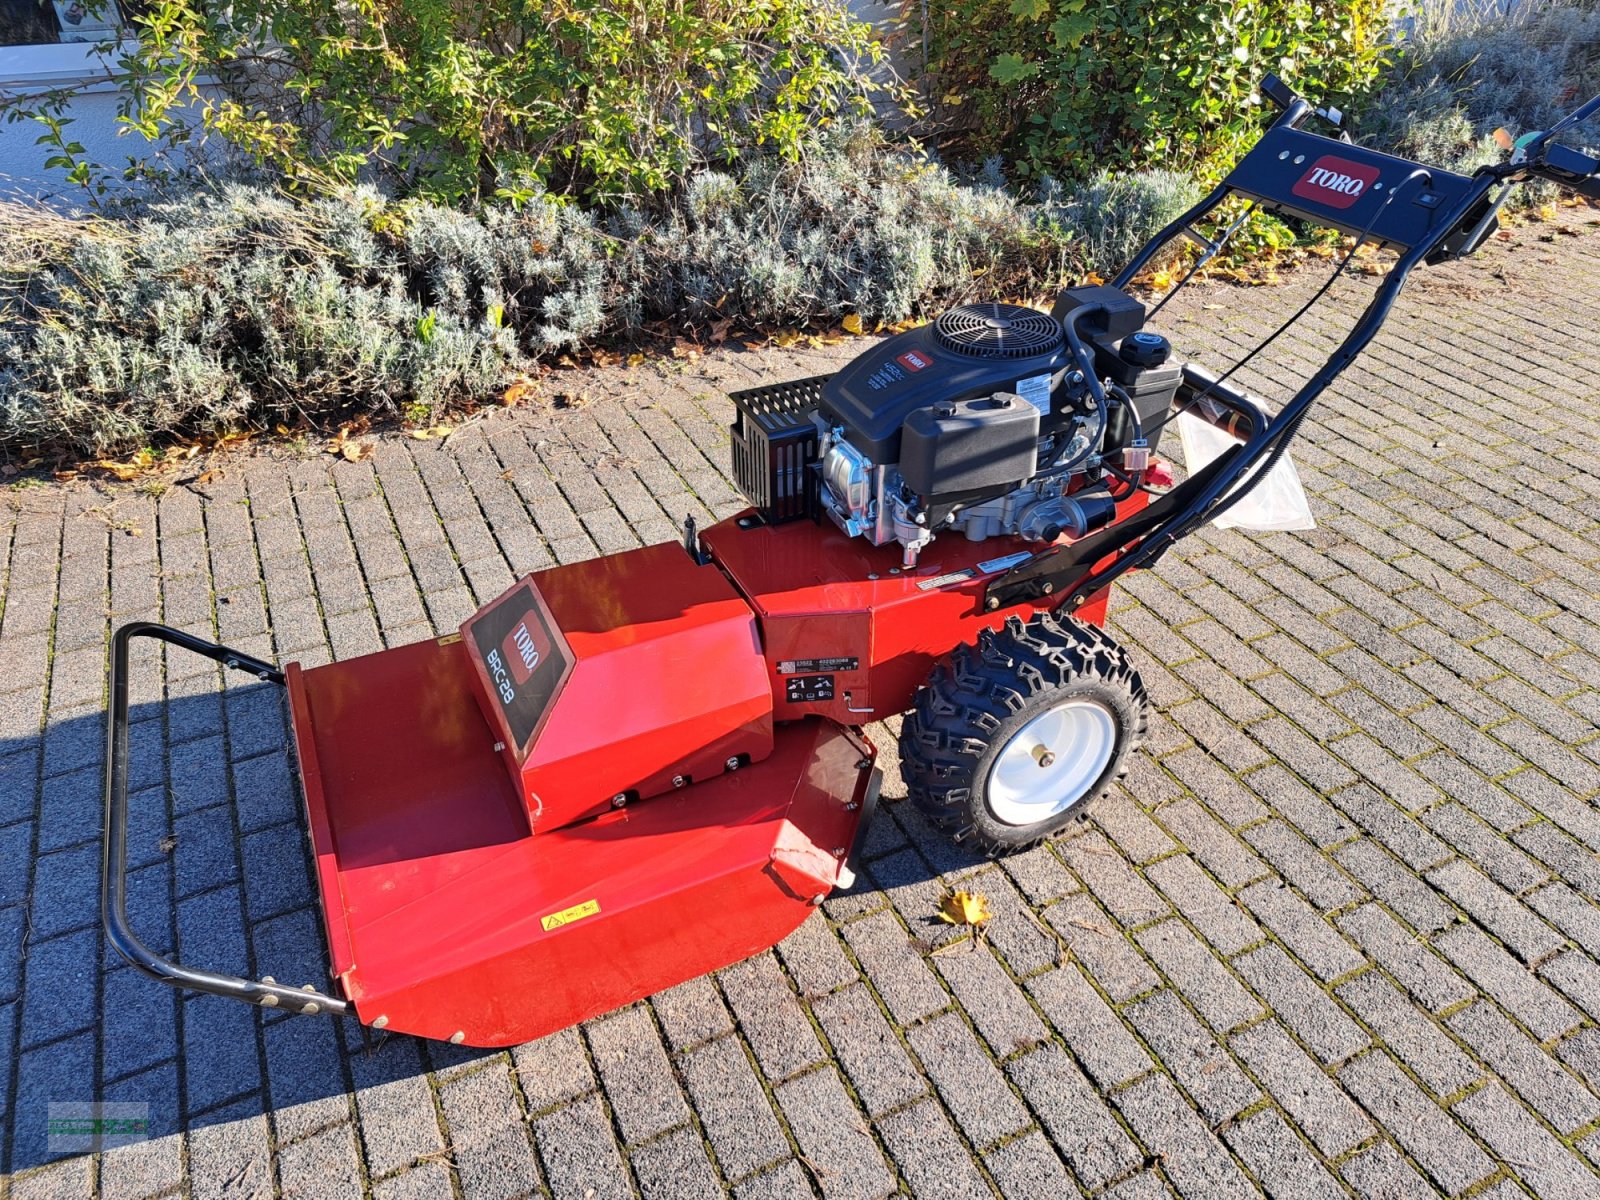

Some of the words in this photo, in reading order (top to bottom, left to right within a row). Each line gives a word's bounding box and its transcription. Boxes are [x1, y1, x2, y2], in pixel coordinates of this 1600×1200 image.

[1307, 167, 1364, 195] TORO
[904, 353, 926, 369] TORO
[513, 622, 539, 669] TORO
